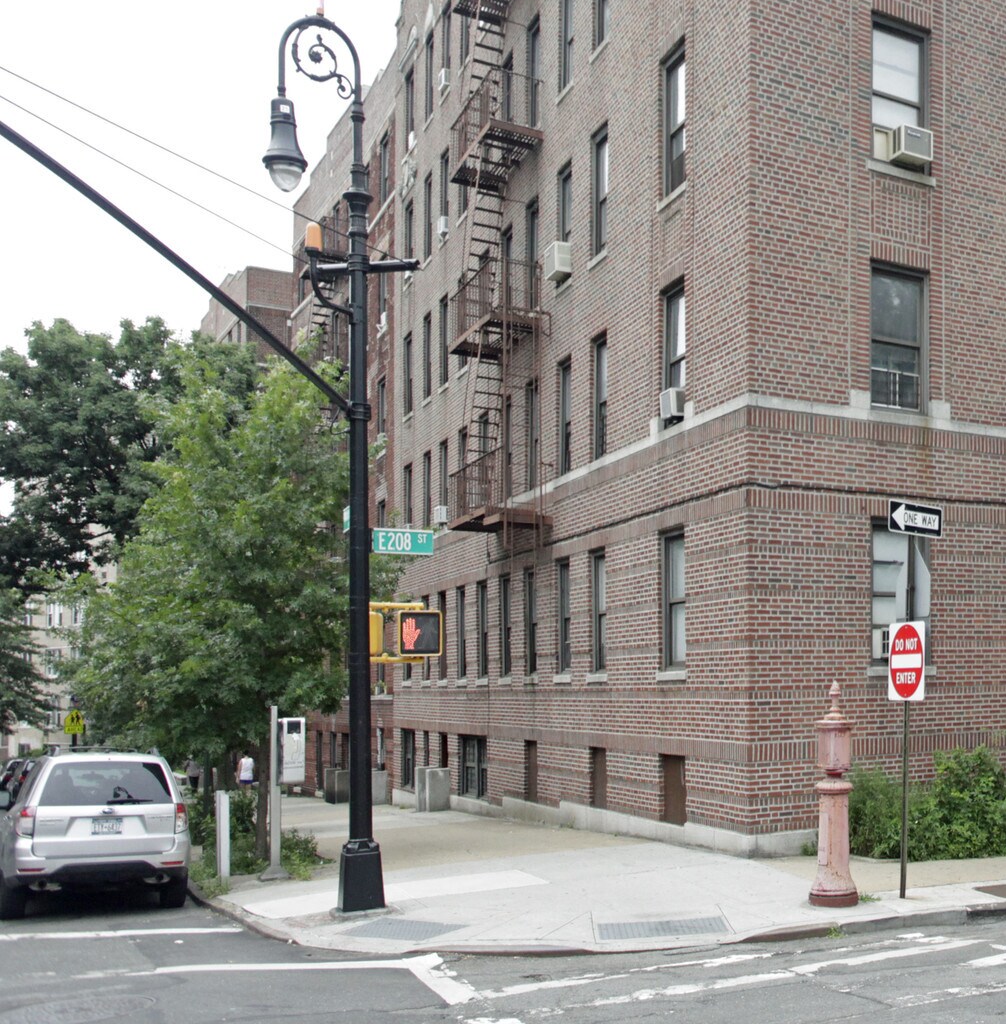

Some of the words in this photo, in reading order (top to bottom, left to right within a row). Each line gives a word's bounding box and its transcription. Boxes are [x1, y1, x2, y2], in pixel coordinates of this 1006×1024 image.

[904, 512, 918, 525] ONE
[921, 515, 937, 527] WAY
[417, 534, 428, 544] ST
[895, 638, 904, 651] DO
[905, 637, 918, 651] NOT
[896, 672, 916, 684] ENTER
